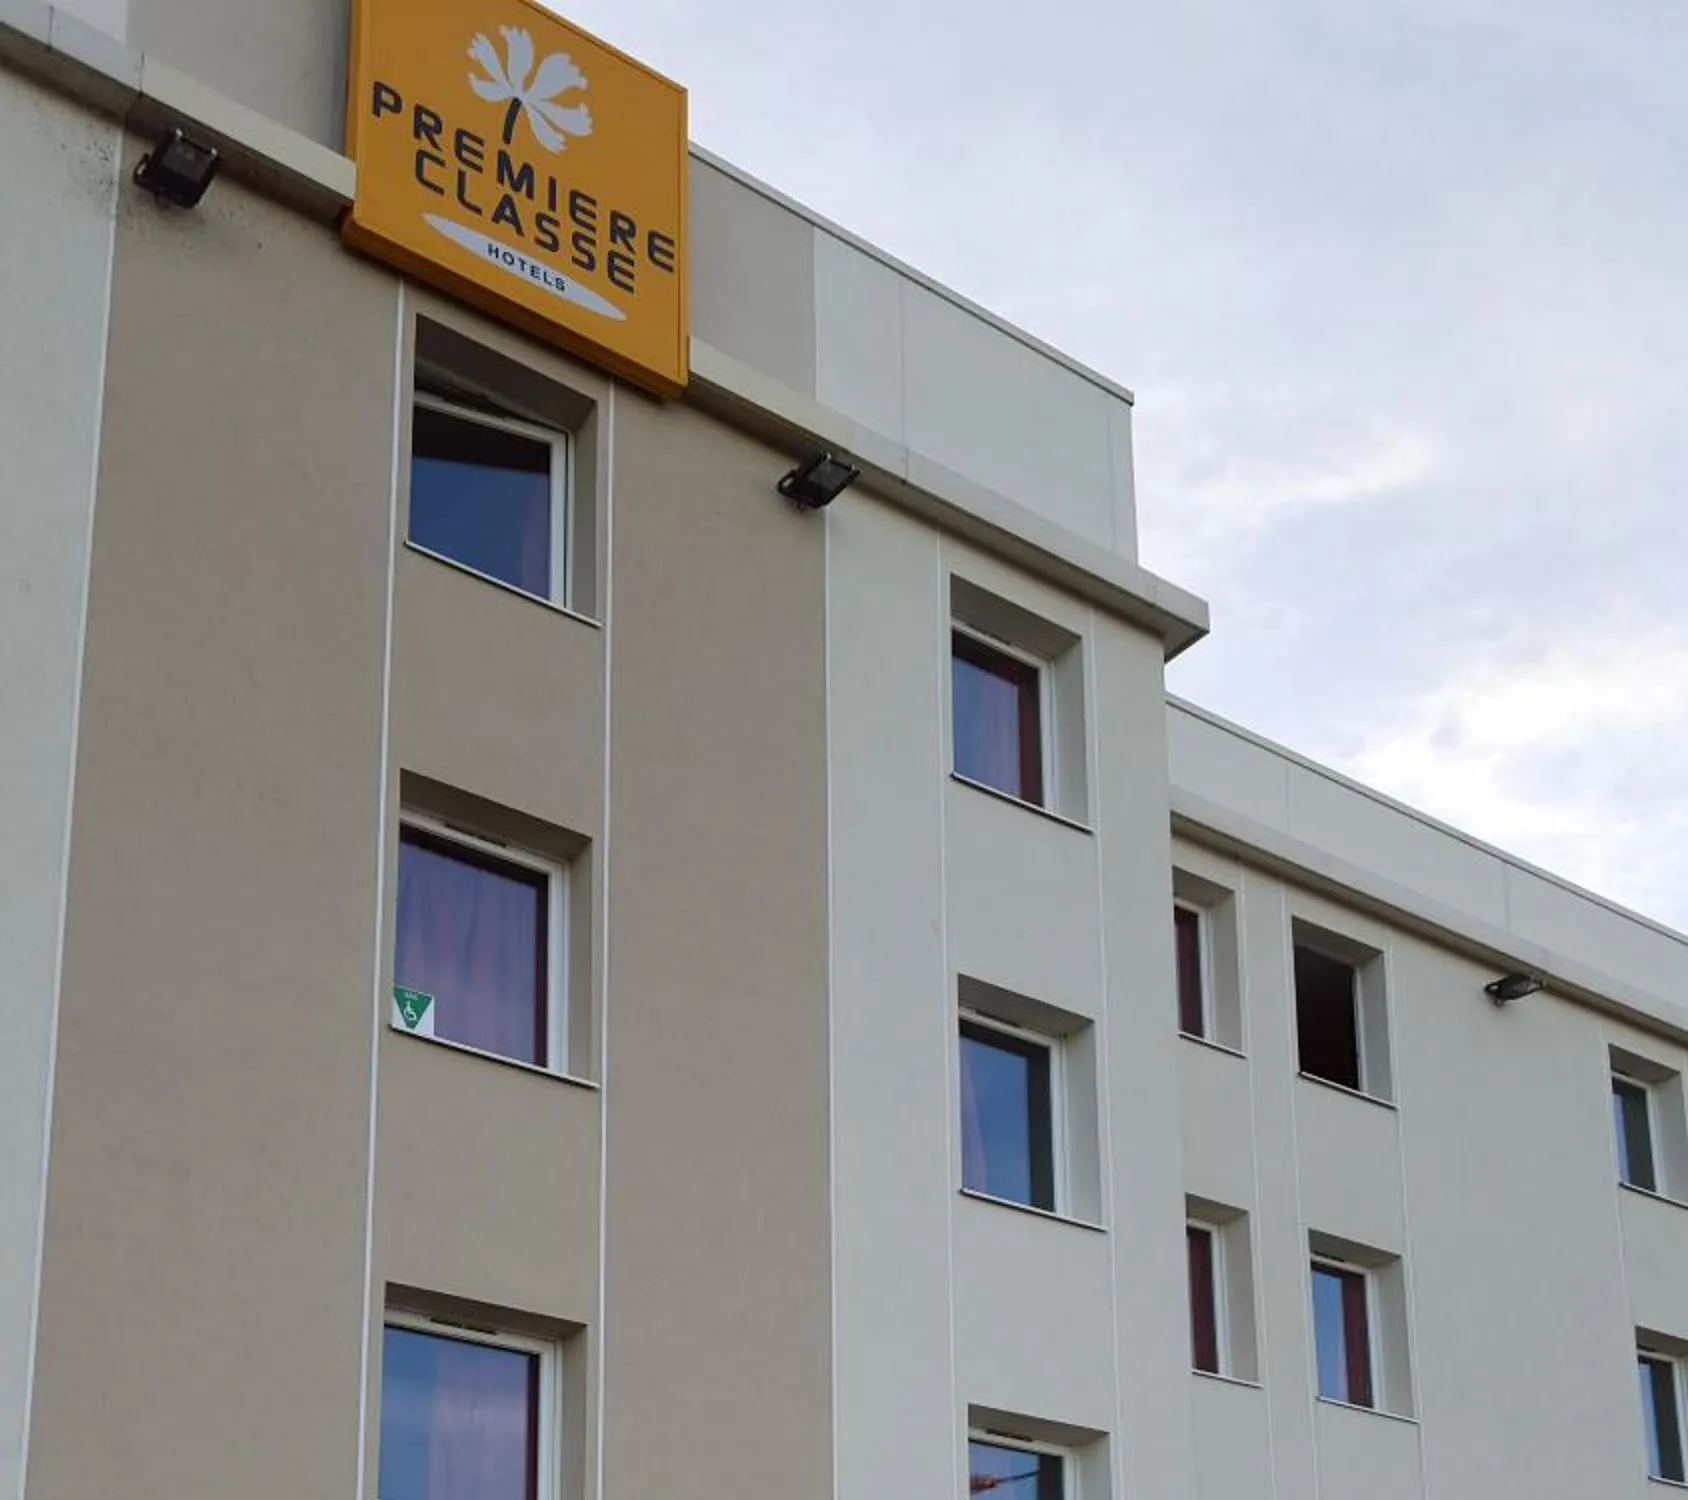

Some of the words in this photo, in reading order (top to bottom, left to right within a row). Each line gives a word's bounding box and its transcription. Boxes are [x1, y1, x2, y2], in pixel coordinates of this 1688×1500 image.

[371, 81, 675, 274] PREMIERE
[415, 150, 635, 294] CLASSE
[487, 243, 566, 293] HOTELS
